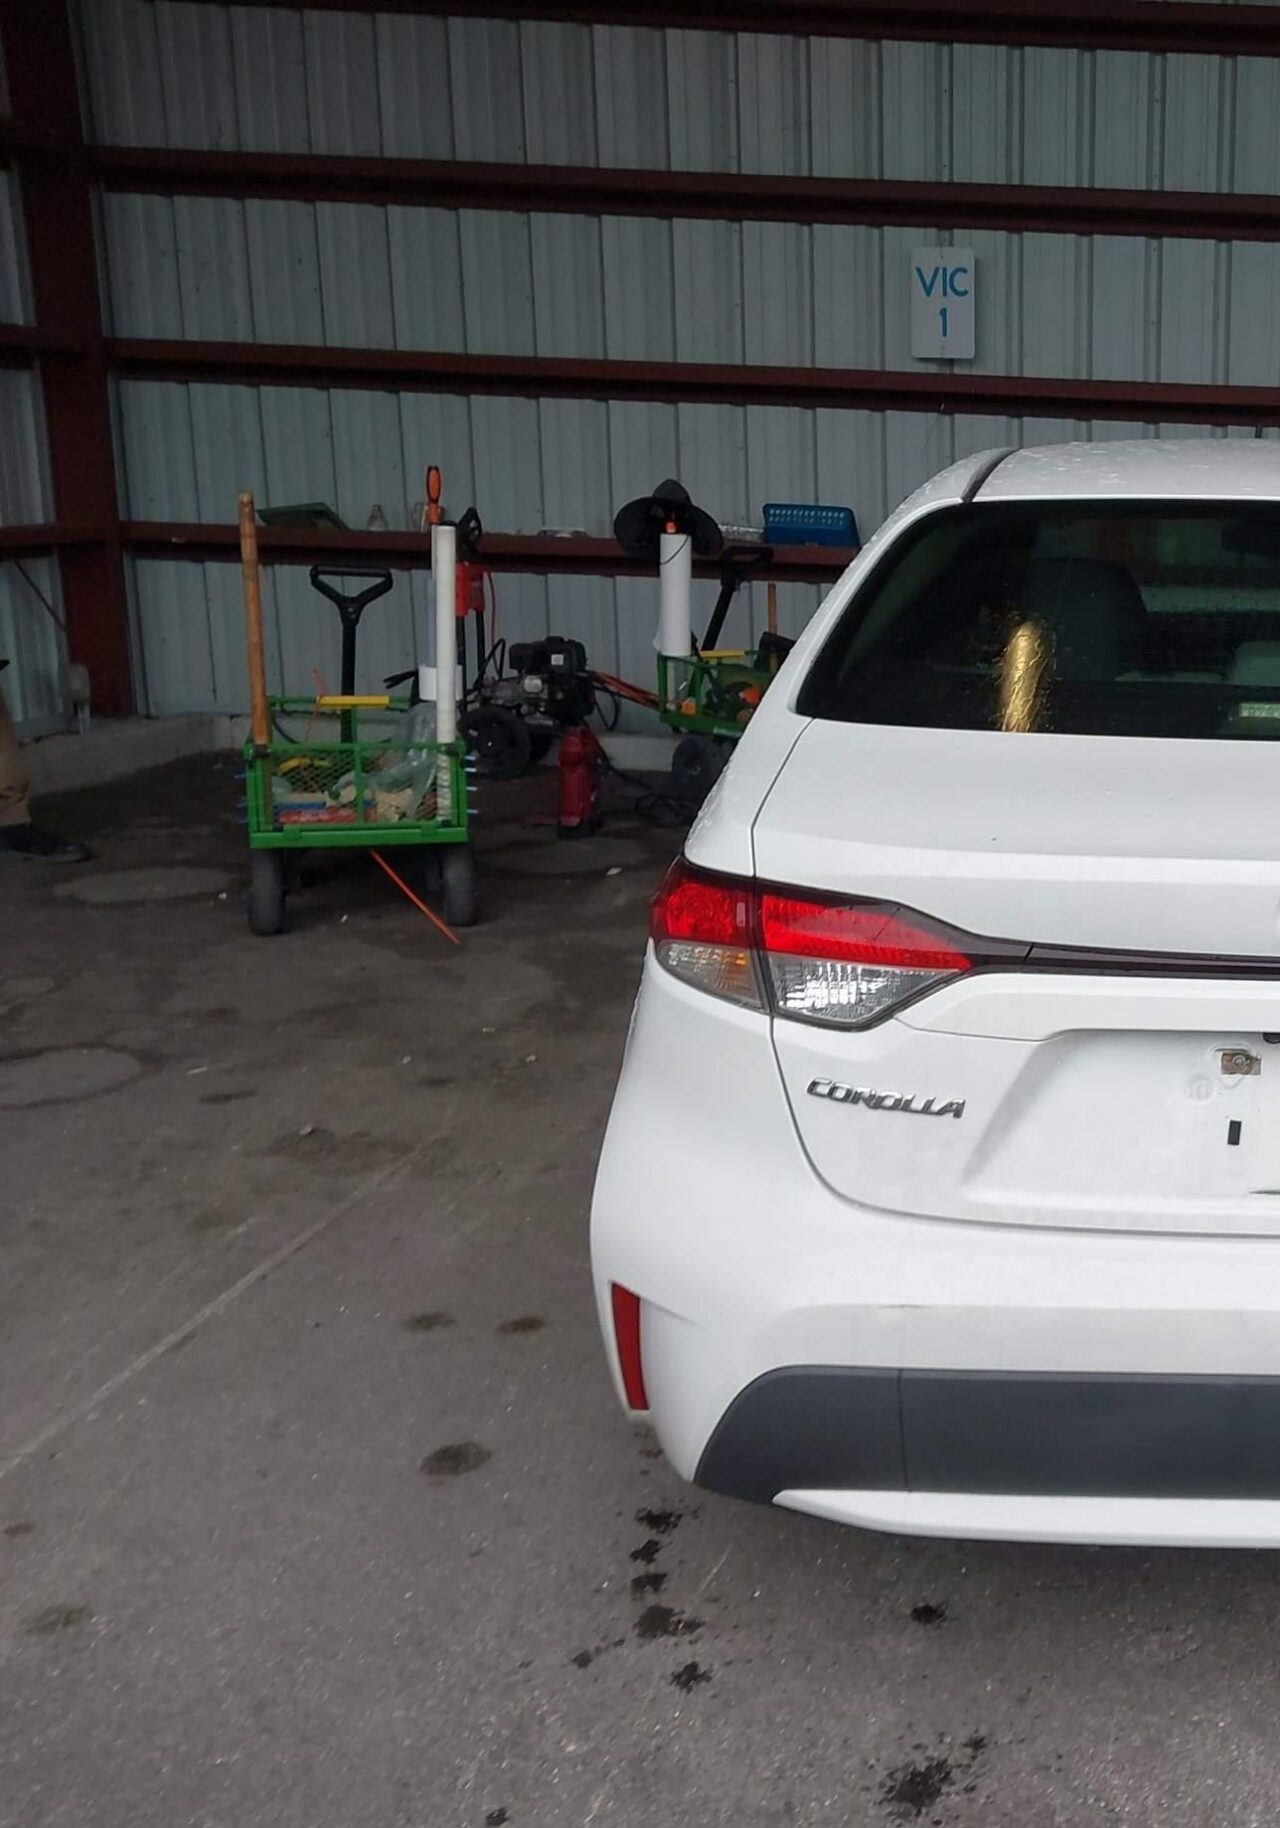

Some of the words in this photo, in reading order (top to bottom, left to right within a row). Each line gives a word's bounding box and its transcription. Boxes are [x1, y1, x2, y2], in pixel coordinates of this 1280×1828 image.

[915, 266, 969, 297] VIC
[938, 307, 948, 338] 1
[806, 1076, 966, 1119] COROLLA
